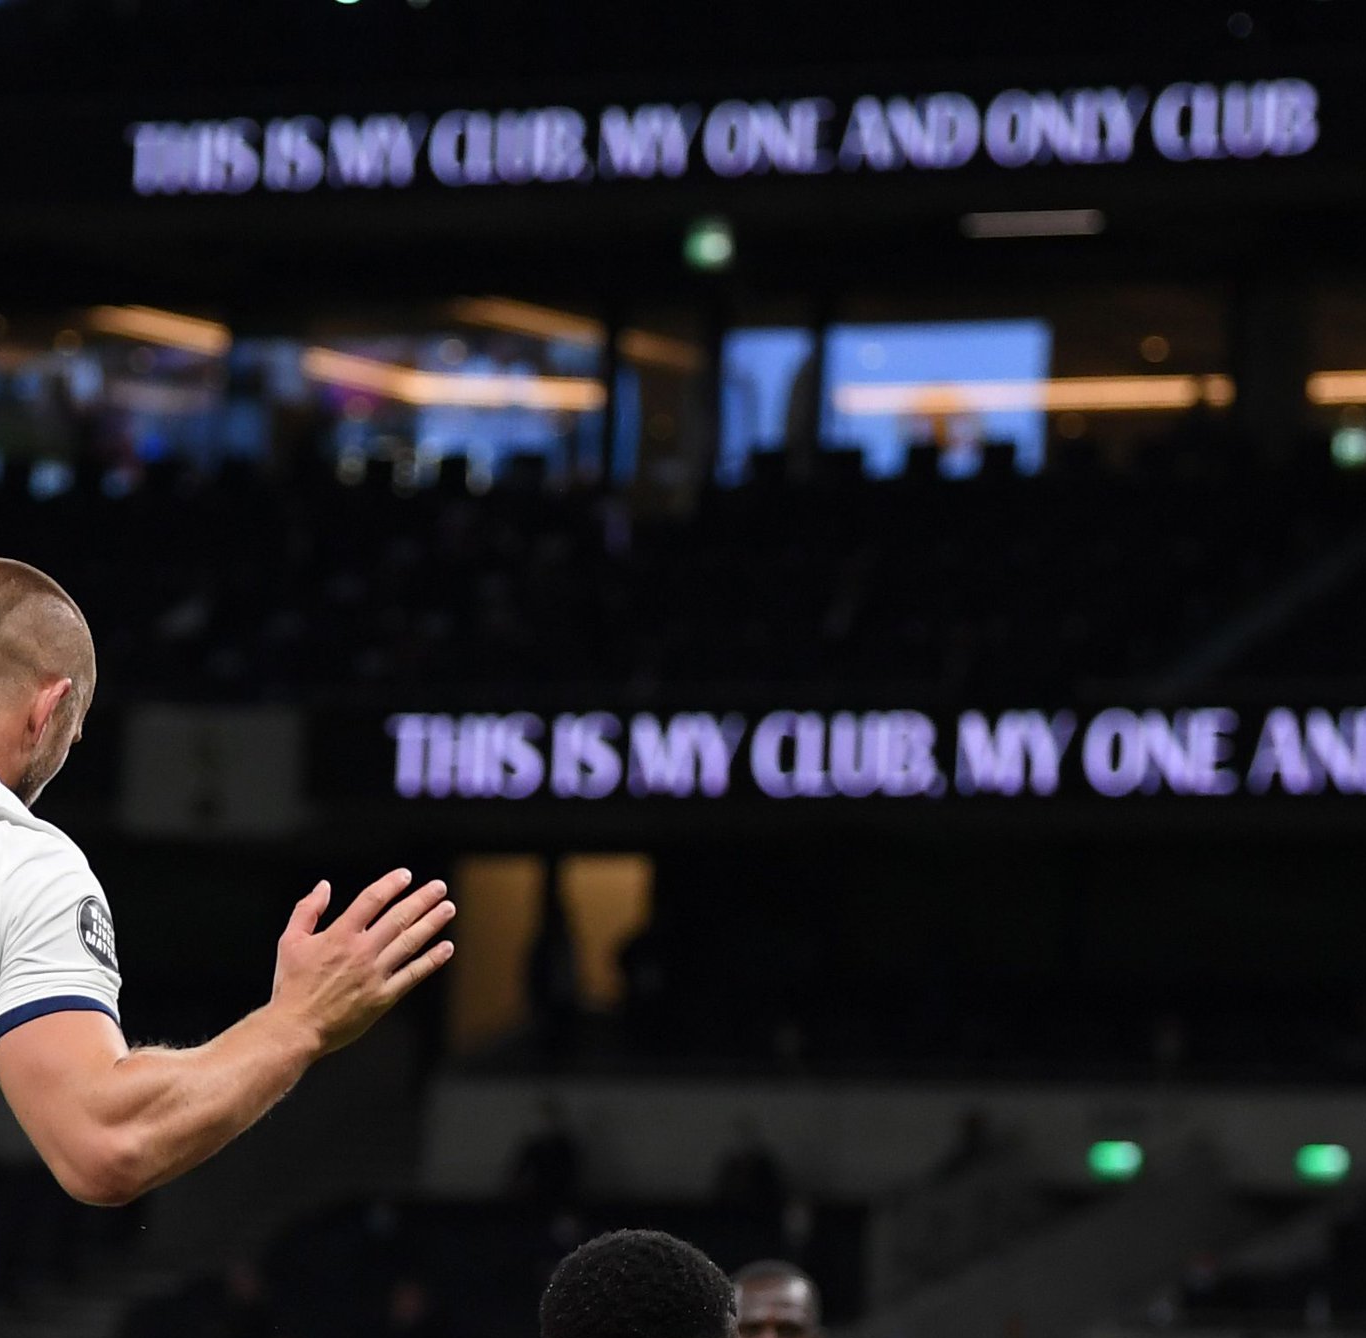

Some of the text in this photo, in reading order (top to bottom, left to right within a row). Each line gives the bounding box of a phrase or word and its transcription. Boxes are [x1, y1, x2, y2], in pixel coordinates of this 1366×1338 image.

[124, 117, 260, 196] THIS
[263, 114, 324, 192] IS
[326, 110, 430, 188] MY
[600, 103, 701, 179] MY
[702, 98, 835, 177] ONE
[837, 91, 980, 171] AND
[985, 85, 1148, 167] ONLY
[1150, 78, 1320, 161] CLUB
[385, 711, 545, 799] THIS
[551, 710, 623, 799] IS
[627, 711, 747, 798] MY
[955, 708, 1077, 797] MY
[1083, 706, 1238, 797] ONE
